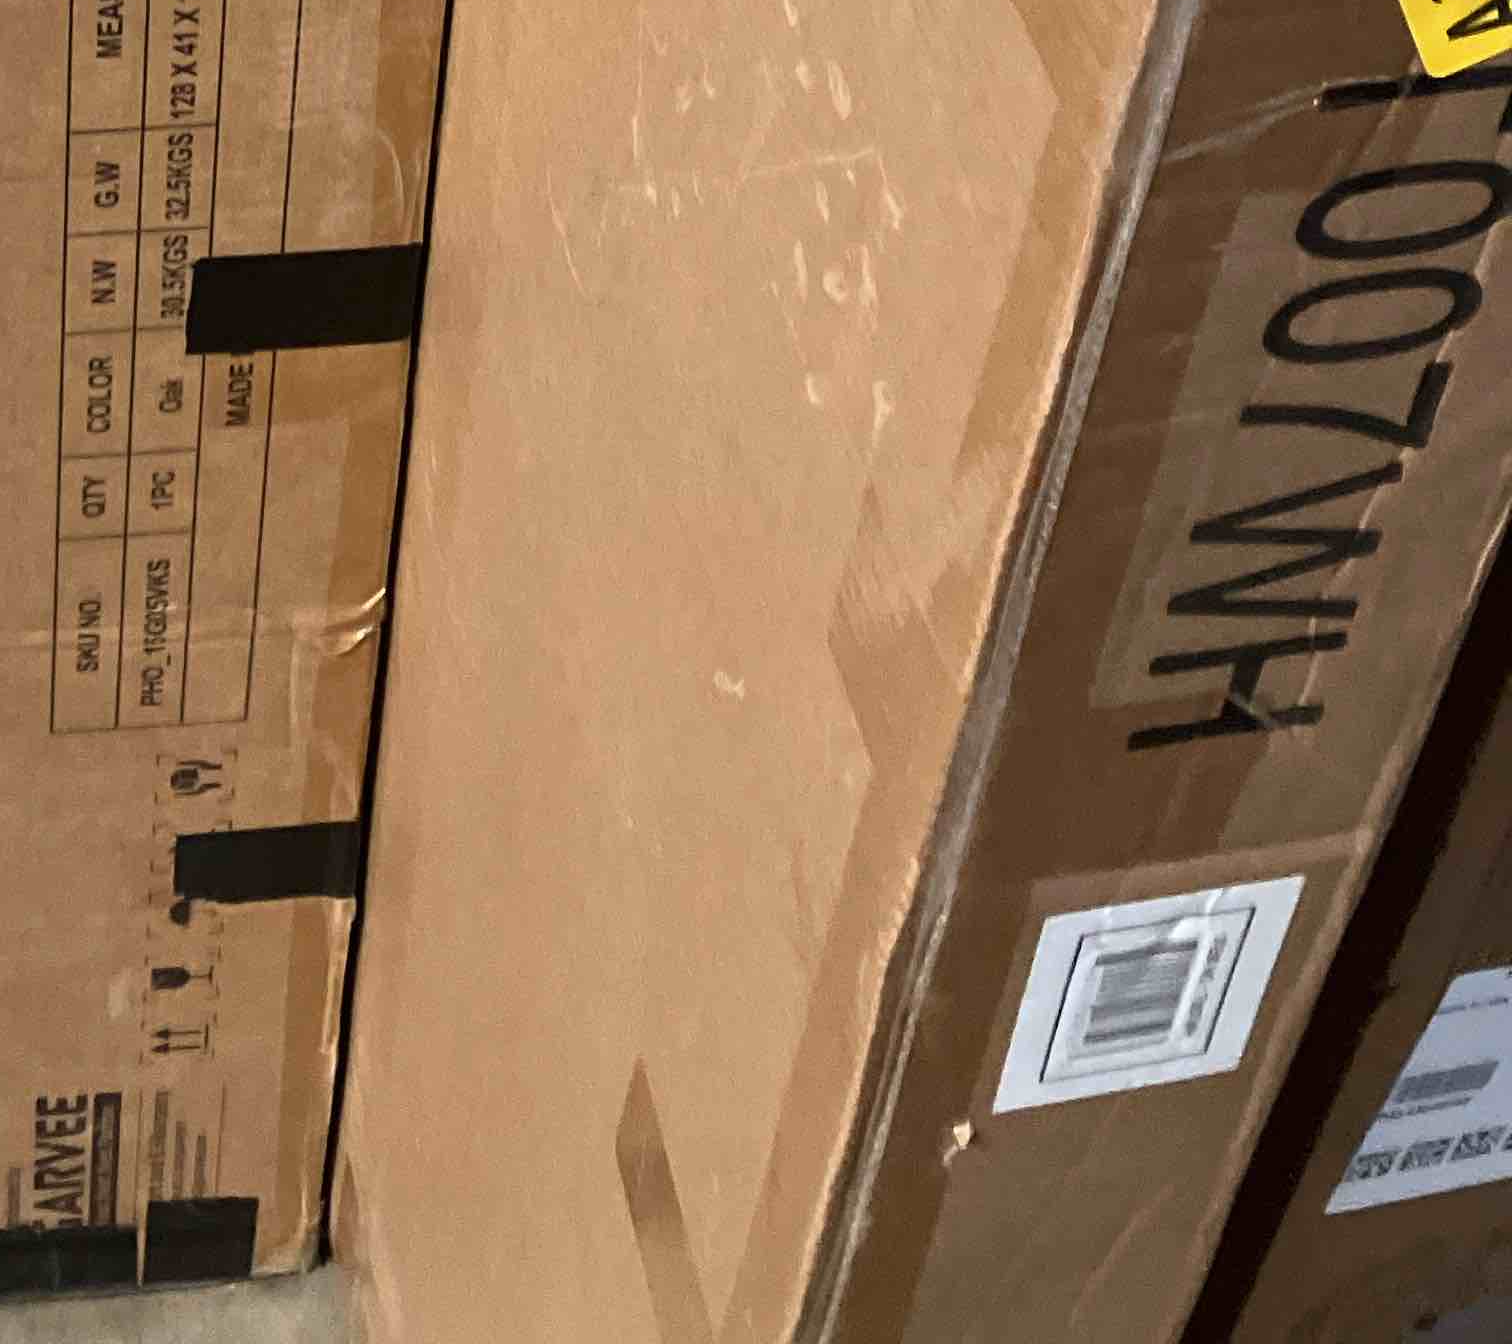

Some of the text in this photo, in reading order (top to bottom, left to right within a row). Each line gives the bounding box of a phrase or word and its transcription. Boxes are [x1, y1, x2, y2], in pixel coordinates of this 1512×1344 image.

[173, 9, 200, 24] X
[172, 31, 199, 56] 41
[171, 61, 197, 77] X
[170, 81, 196, 119] 128
[94, 160, 121, 209] G.W
[165, 132, 193, 221] 32.5KGS
[91, 260, 118, 305] N.W
[161, 234, 189, 320] 30.5KGS
[87, 355, 113, 434] COLOR
[225, 362, 254, 428] MADE
[81, 475, 106, 518] QTY
[151, 471, 175, 511] 1PC
[76, 634, 100, 673] SKU
